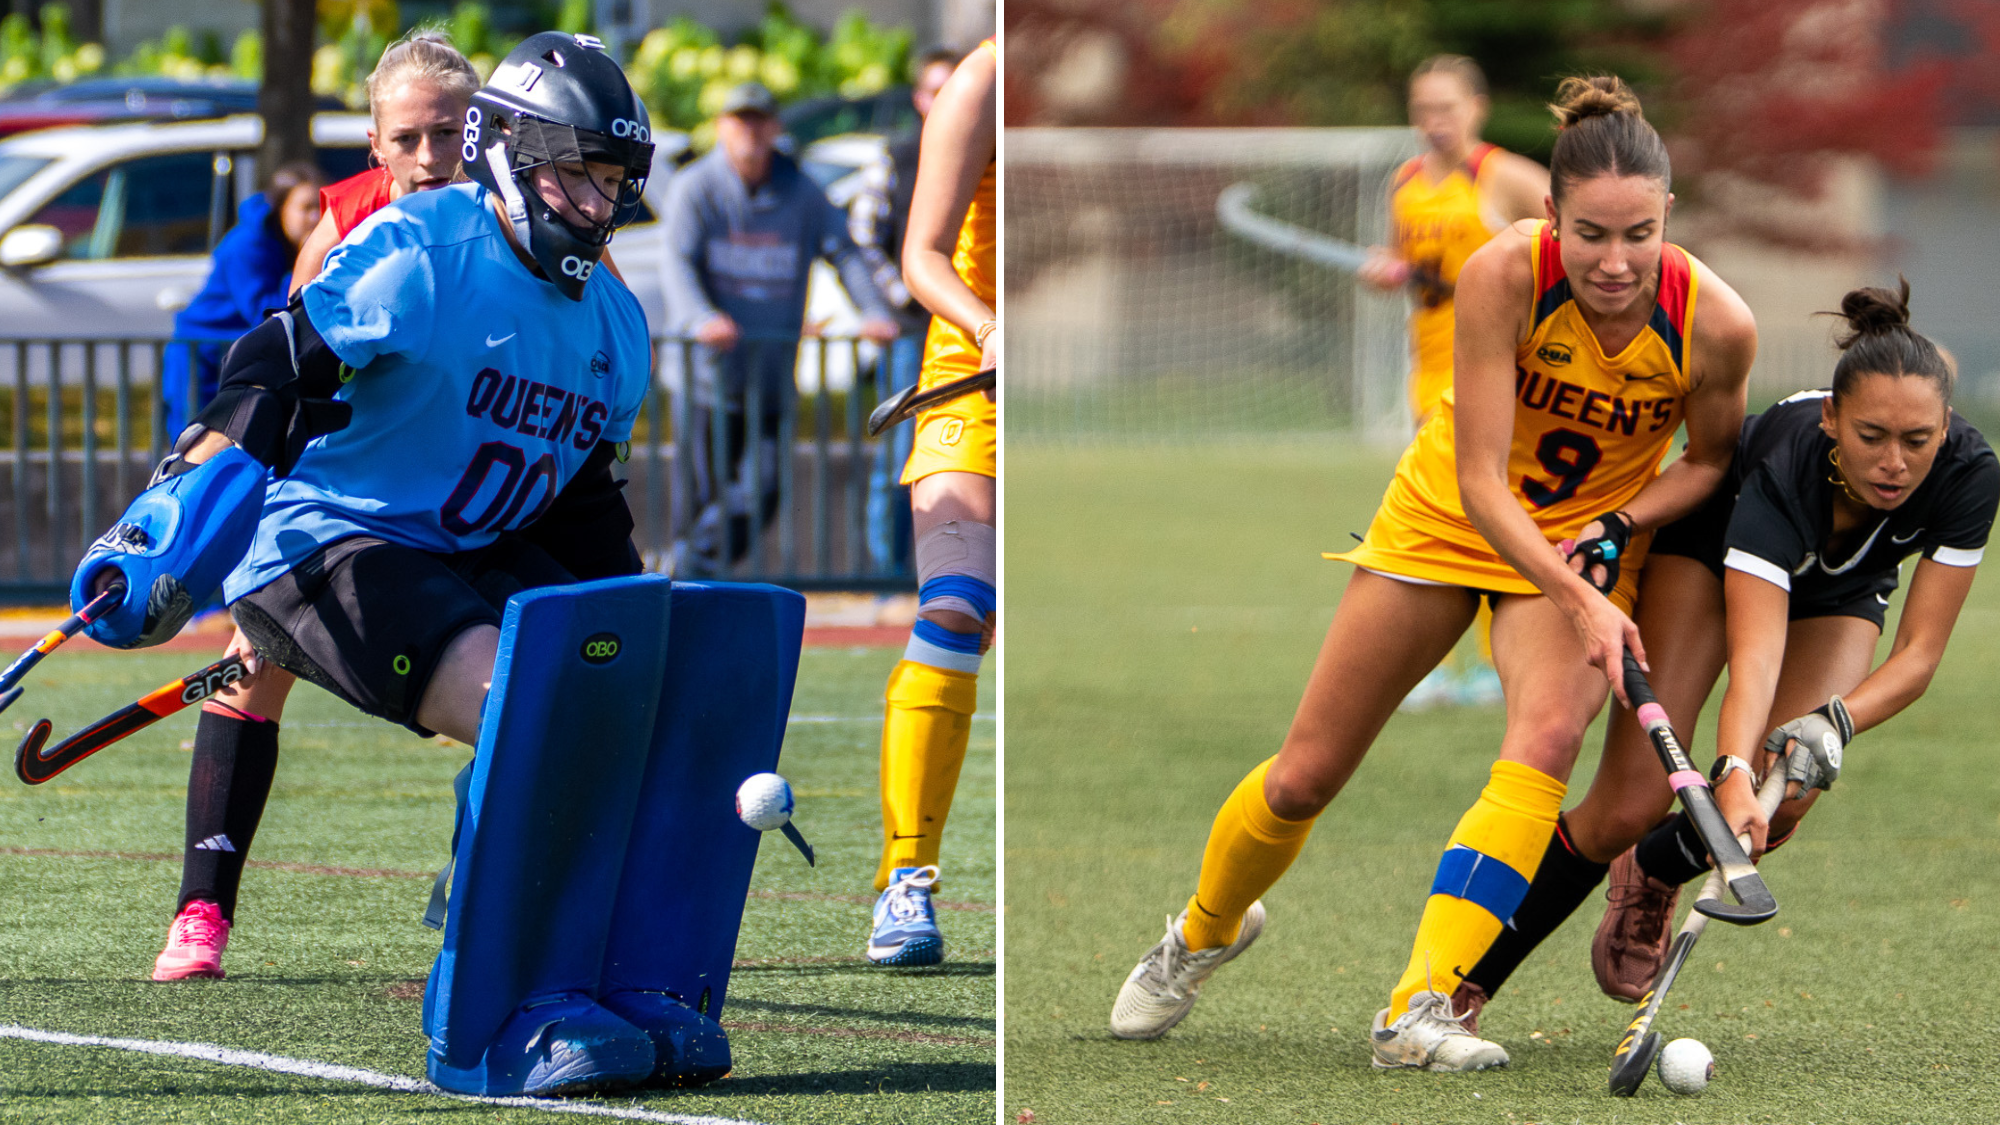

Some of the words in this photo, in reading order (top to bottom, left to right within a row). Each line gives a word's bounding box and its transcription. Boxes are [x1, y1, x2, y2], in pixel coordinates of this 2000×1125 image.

[462, 106, 483, 162] OBO
[611, 118, 650, 142] OBO
[561, 255, 594, 282] OB
[1536, 347, 1573, 364] OUA
[466, 366, 609, 452] QUEEN'S
[439, 440, 558, 539] 00
[1519, 426, 1604, 510] 9
[586, 640, 618, 657] OBO
[181, 653, 263, 704] Gra
[1658, 726, 1694, 772] ITUAL
